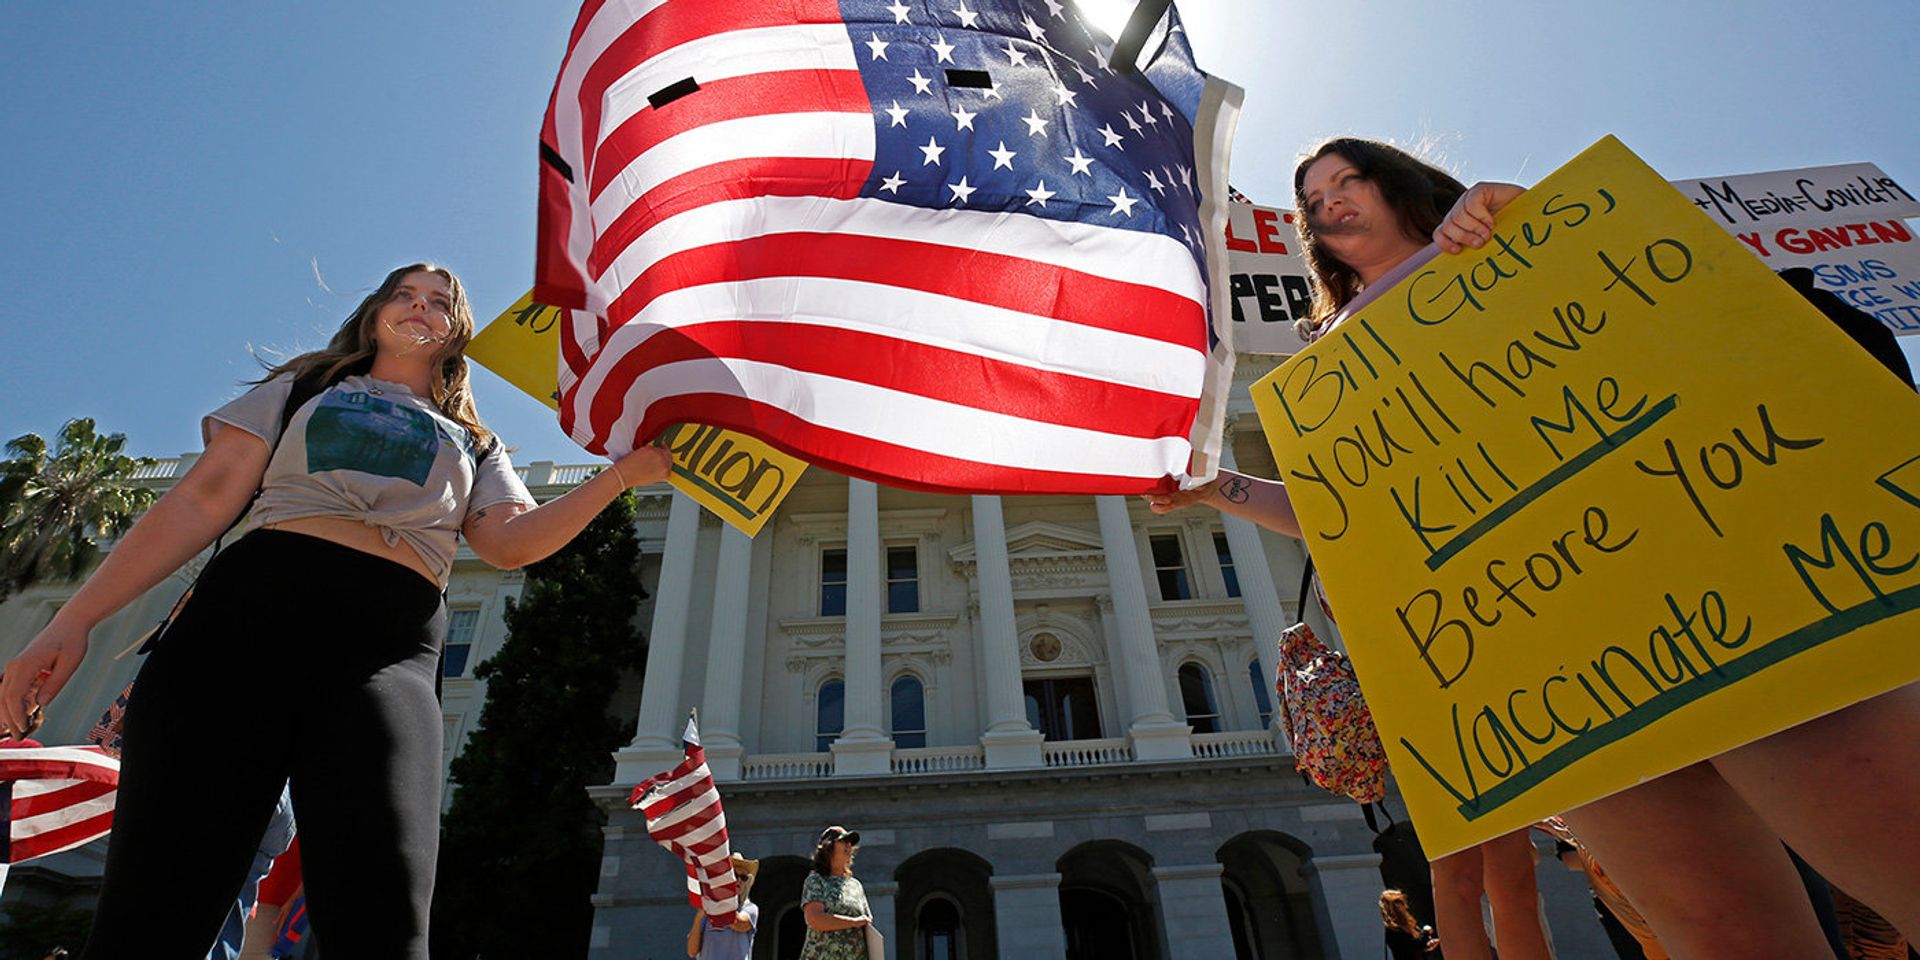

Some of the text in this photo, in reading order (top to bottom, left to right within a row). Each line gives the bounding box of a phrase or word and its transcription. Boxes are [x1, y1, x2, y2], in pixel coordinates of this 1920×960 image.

[1273, 189, 1616, 437] Bill Gates,
[1775, 219, 1912, 254] GAVIN
[1812, 259, 1897, 287] SOWS
[1291, 238, 1692, 540] you'll have to
[1390, 377, 1648, 555] Kill Me
[1396, 404, 1825, 689] Before You
[1400, 590, 1752, 811] Vaccinate
